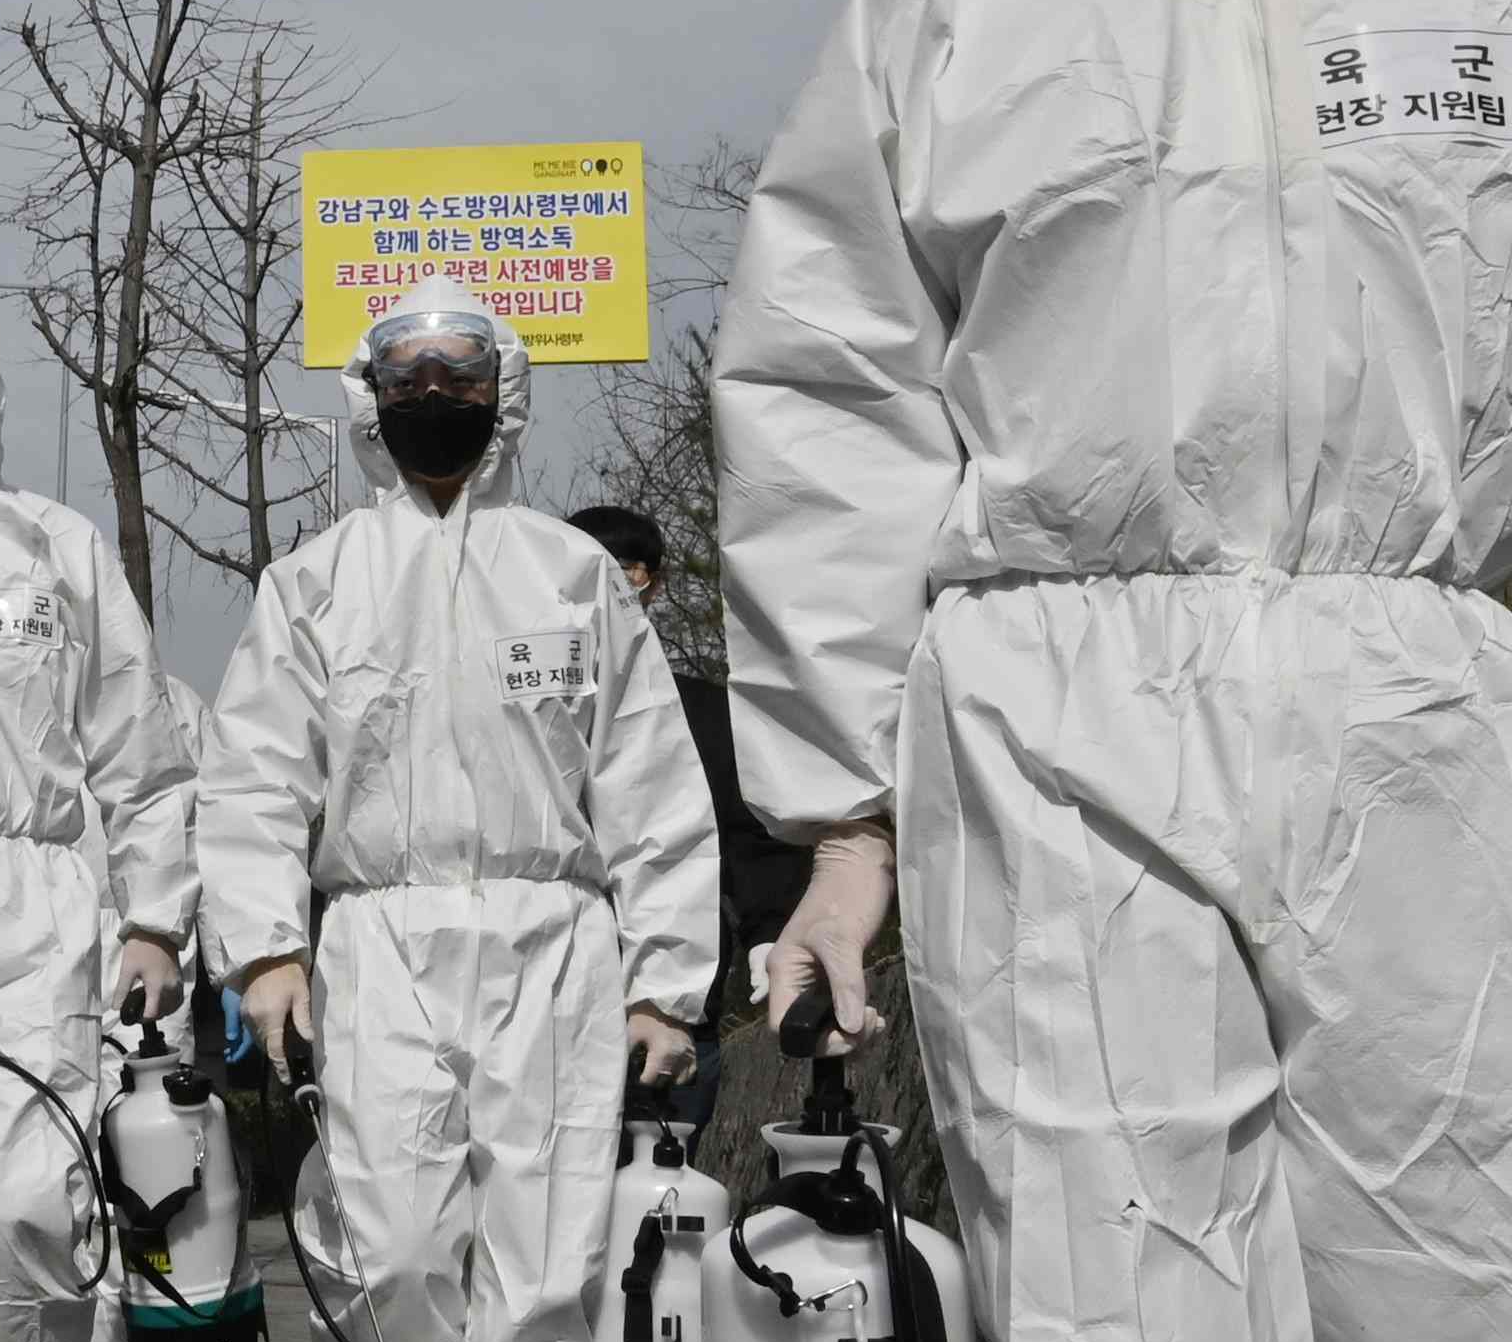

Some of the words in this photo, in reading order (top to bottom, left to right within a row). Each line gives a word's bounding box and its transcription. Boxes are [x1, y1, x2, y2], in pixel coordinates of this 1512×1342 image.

[1320, 48, 1367, 85] 육
[1451, 44, 1494, 83] 군
[1316, 93, 1387, 136] 현장
[1403, 90, 1506, 127] 지원팀
[318, 197, 410, 224] 강남구와
[418, 191, 629, 219] 수도방위사령부에서
[373, 230, 419, 254] 함께
[427, 230, 472, 253] 하는
[480, 226, 573, 251] 방역소독
[443, 260, 490, 284] 관련
[497, 256, 614, 283] 사전예방을
[519, 332, 584, 348] 방위사령부
[34, 595, 51, 615] 군
[12, 618, 53, 638] 지원팀
[510, 643, 532, 664] 육
[506, 669, 542, 690] 현장
